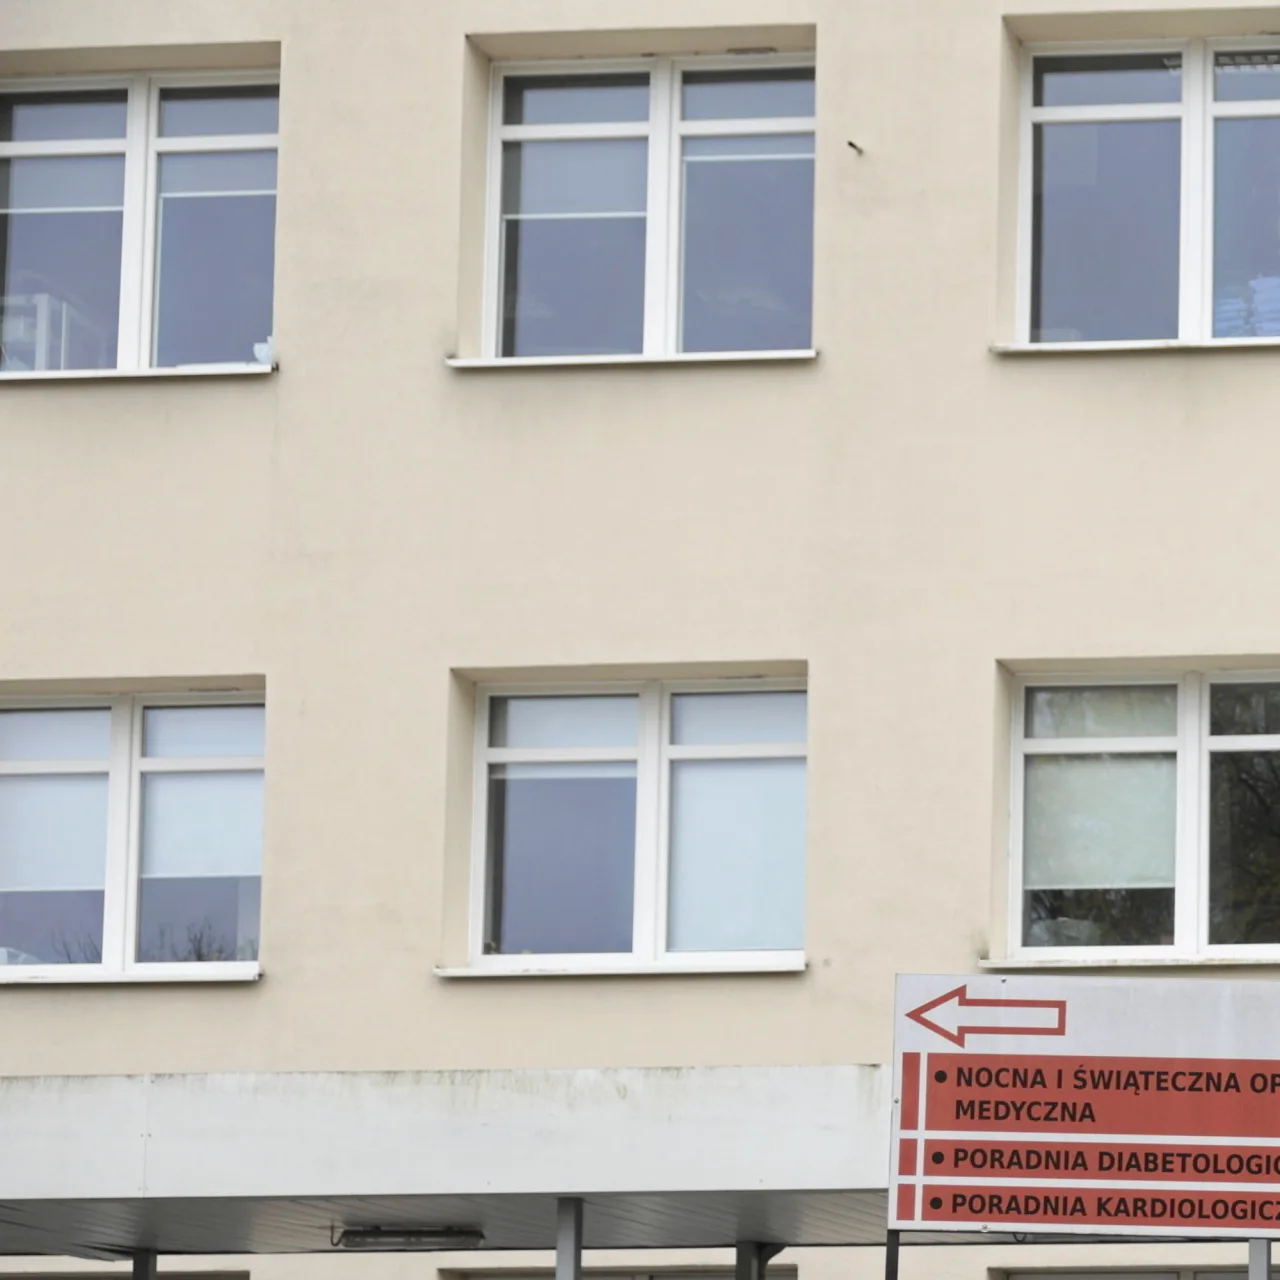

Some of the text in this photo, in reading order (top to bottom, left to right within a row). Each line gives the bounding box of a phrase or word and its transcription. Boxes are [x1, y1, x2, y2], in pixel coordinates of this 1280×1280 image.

[955, 1067, 1048, 1090] NOCNA
[1056, 1069, 1064, 1090] I
[1073, 1065, 1242, 1096] ŚWIĄTECZNA
[955, 1100, 1096, 1123] MEDYCZNA
[953, 1148, 1089, 1171] PORADNIA
[951, 1194, 1088, 1217] PORADNIA
